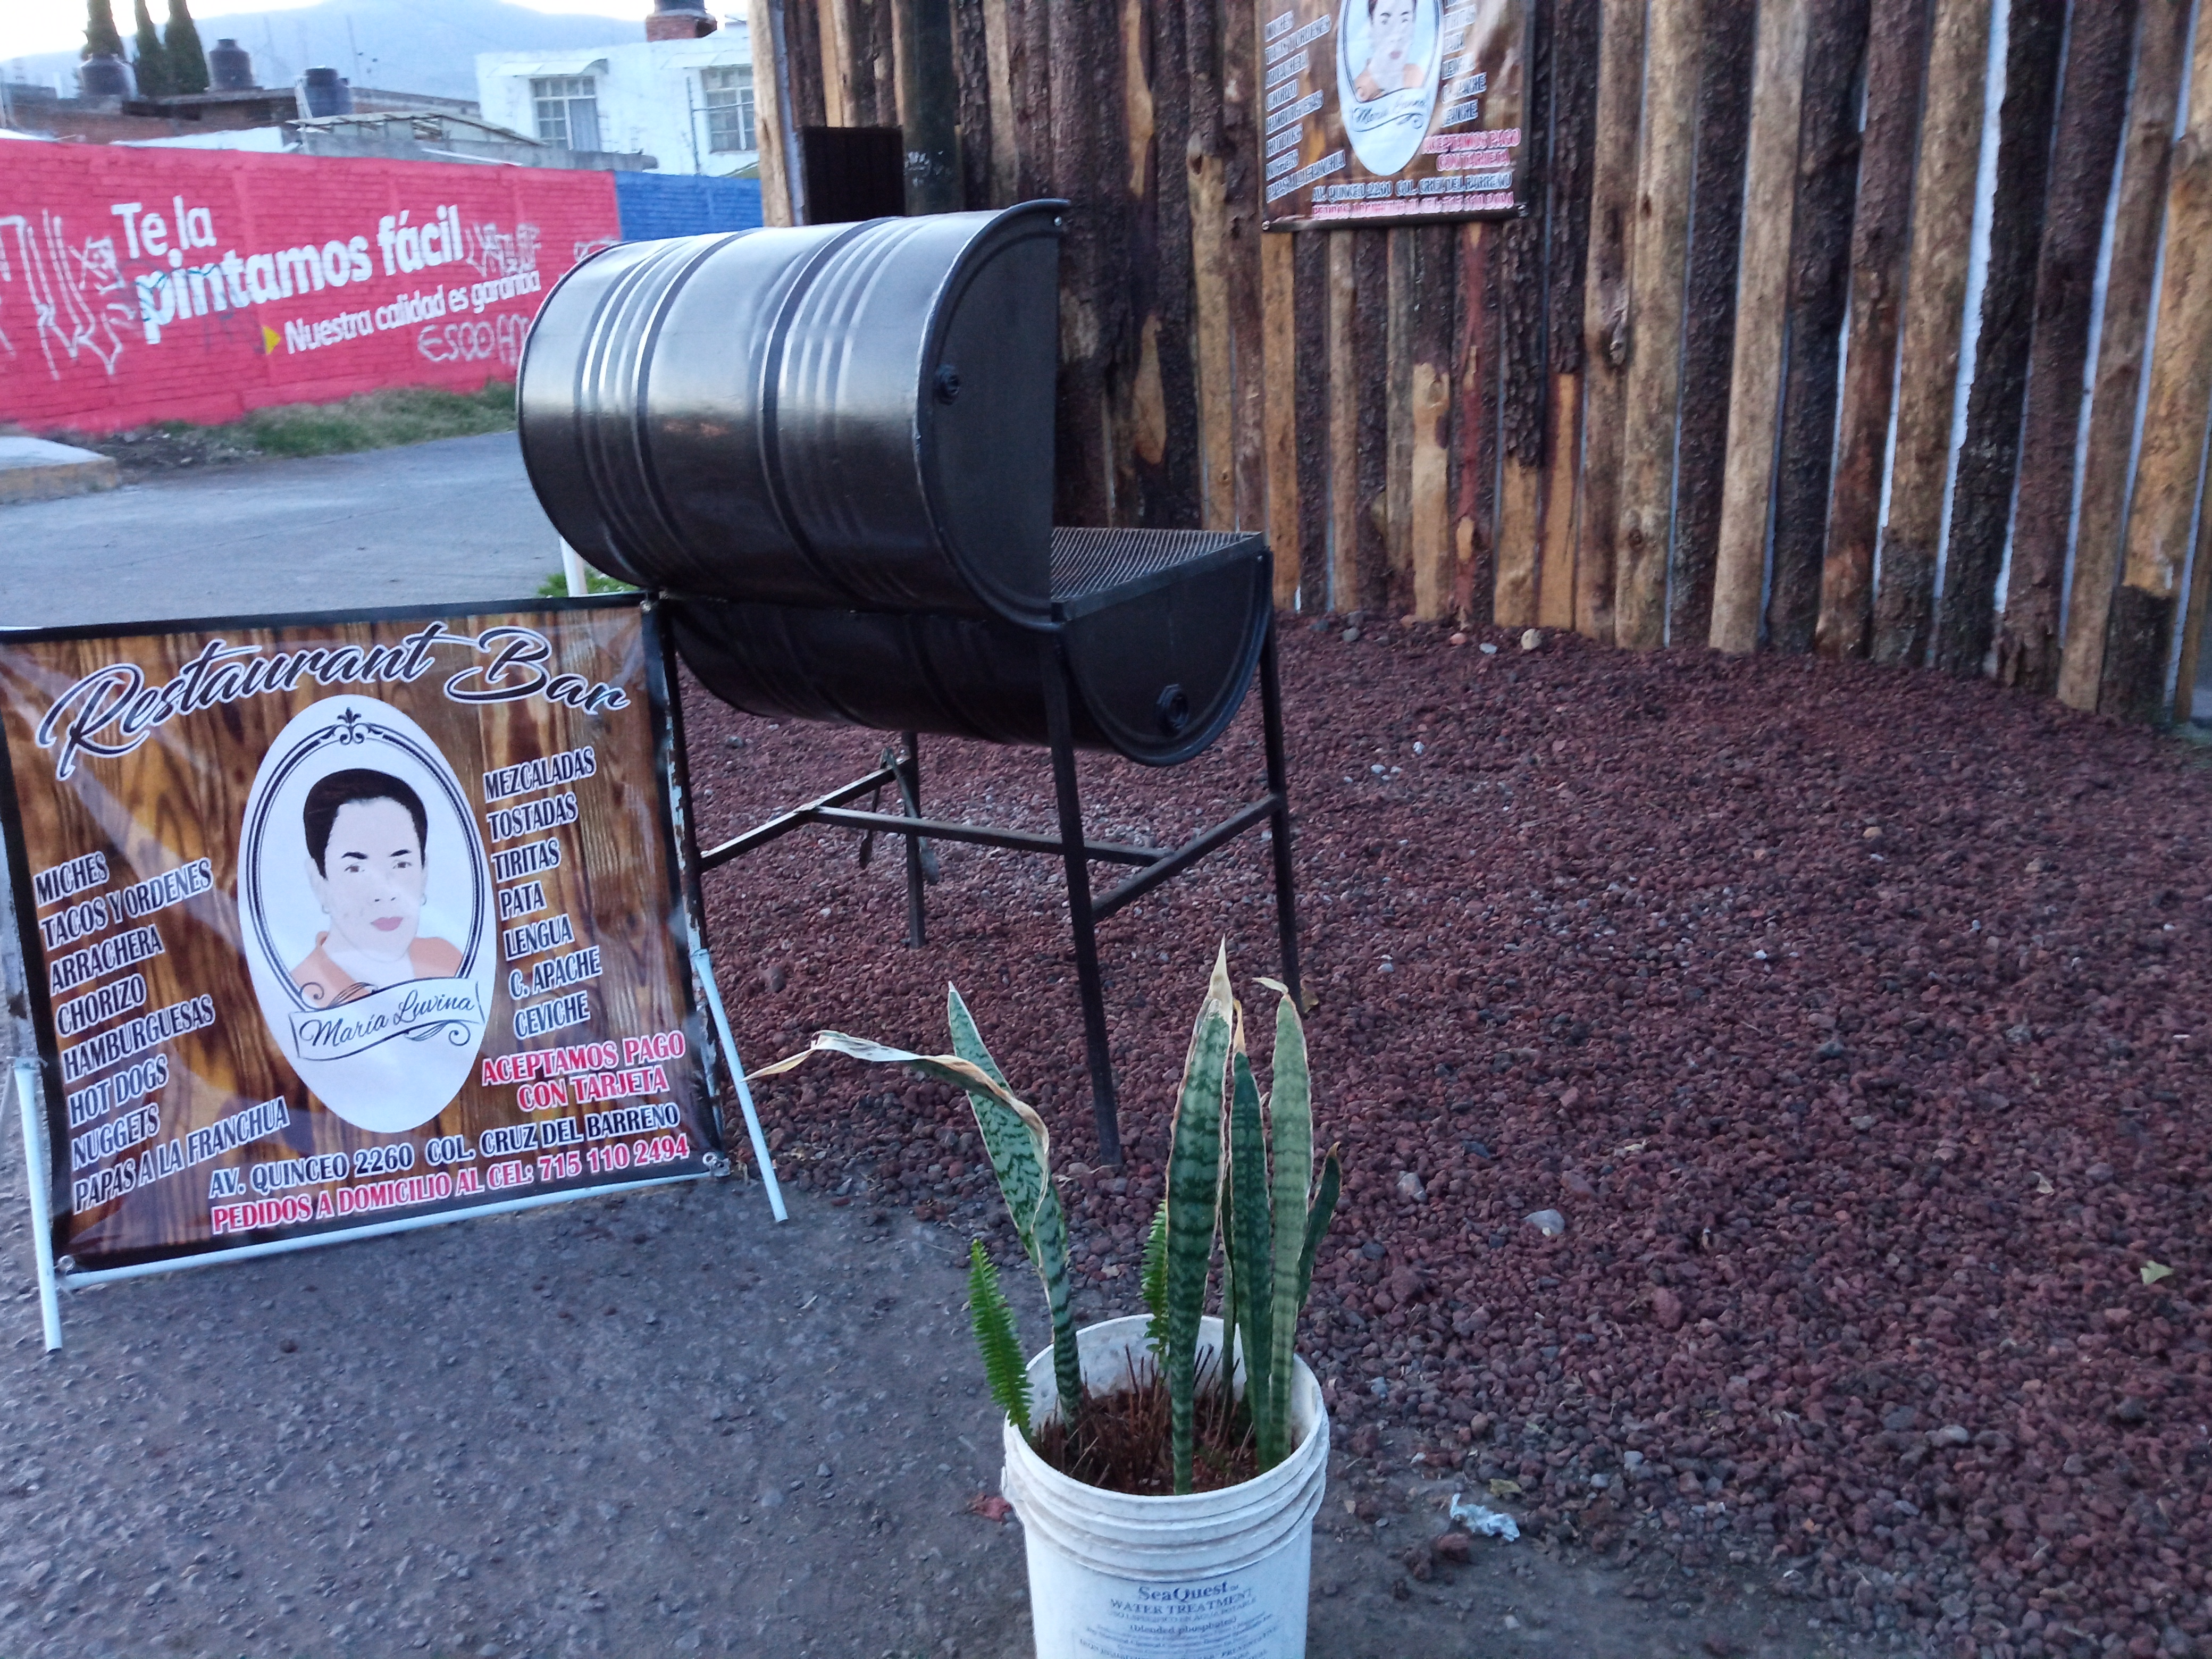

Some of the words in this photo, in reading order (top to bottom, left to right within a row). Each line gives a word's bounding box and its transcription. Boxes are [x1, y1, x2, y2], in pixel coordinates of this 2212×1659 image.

[111, 202, 168, 259] Te
[173, 196, 216, 249] la
[136, 236, 372, 344] pintamos
[377, 204, 464, 275] fácil
[284, 309, 374, 355] Nuestra
[375, 284, 446, 330] calidad
[448, 286, 468, 312] es
[35, 621, 479, 781] Restaurant
[444, 625, 631, 715] Bar
[483, 746, 596, 803] MEZCALADAS
[487, 791, 579, 843] TOSTADAS
[33, 851, 110, 908] MICHES
[491, 837, 560, 884] TIRITAS
[39, 896, 108, 951] TACOS
[107, 889, 124, 924] Y
[123, 857, 213, 918] ORDENES
[499, 880, 547, 921] PATA
[50, 924, 165, 996] ARRACHERA
[502, 914, 575, 961] LENGUA
[508, 969, 530, 1001] C.
[532, 945, 602, 996] APACHE
[55, 973, 147, 1037] CHORIZO
[299, 1013, 389, 1047] María
[393, 989, 475, 1026] Luvina
[513, 991, 591, 1041] CEVICHE
[61, 994, 215, 1084] HAMBURGUESAS
[482, 1040, 619, 1086] ACEPTAMOS
[623, 1030, 686, 1067] PAGO
[68, 1081, 111, 1128] HOT
[113, 1053, 169, 1108] DOGS
[517, 1080, 568, 1112] CON
[570, 1066, 670, 1104] TARJETA
[72, 1102, 160, 1170] NUGGETS
[73, 1158, 135, 1215] PAPAS
[138, 1150, 156, 1187] A
[156, 1138, 186, 1178] LA
[186, 1096, 291, 1167] FRANCHUA
[208, 1167, 247, 1199] AV.
[250, 1152, 350, 1195] QUINCEO
[353, 1142, 415, 1177] 2260
[425, 1136, 475, 1166] COL.
[480, 1121, 539, 1157] CRUZ
[541, 1116, 584, 1145] DEL
[585, 1102, 681, 1140] BARRENO
[211, 1193, 313, 1235] PEDIDOS
[315, 1190, 335, 1219] A
[337, 1172, 452, 1217] DOMICILIO
[455, 1168, 484, 1197] AL
[487, 1160, 534, 1191] CEL:
[537, 1150, 582, 1182] 715
[586, 1143, 630, 1174] 110
[633, 1133, 690, 1166] 2494
[1110, 1598, 1162, 1614] WATER
[1167, 1588, 1251, 1614] TREATMENT
[1138, 1581, 1228, 1602] SeaQuest
